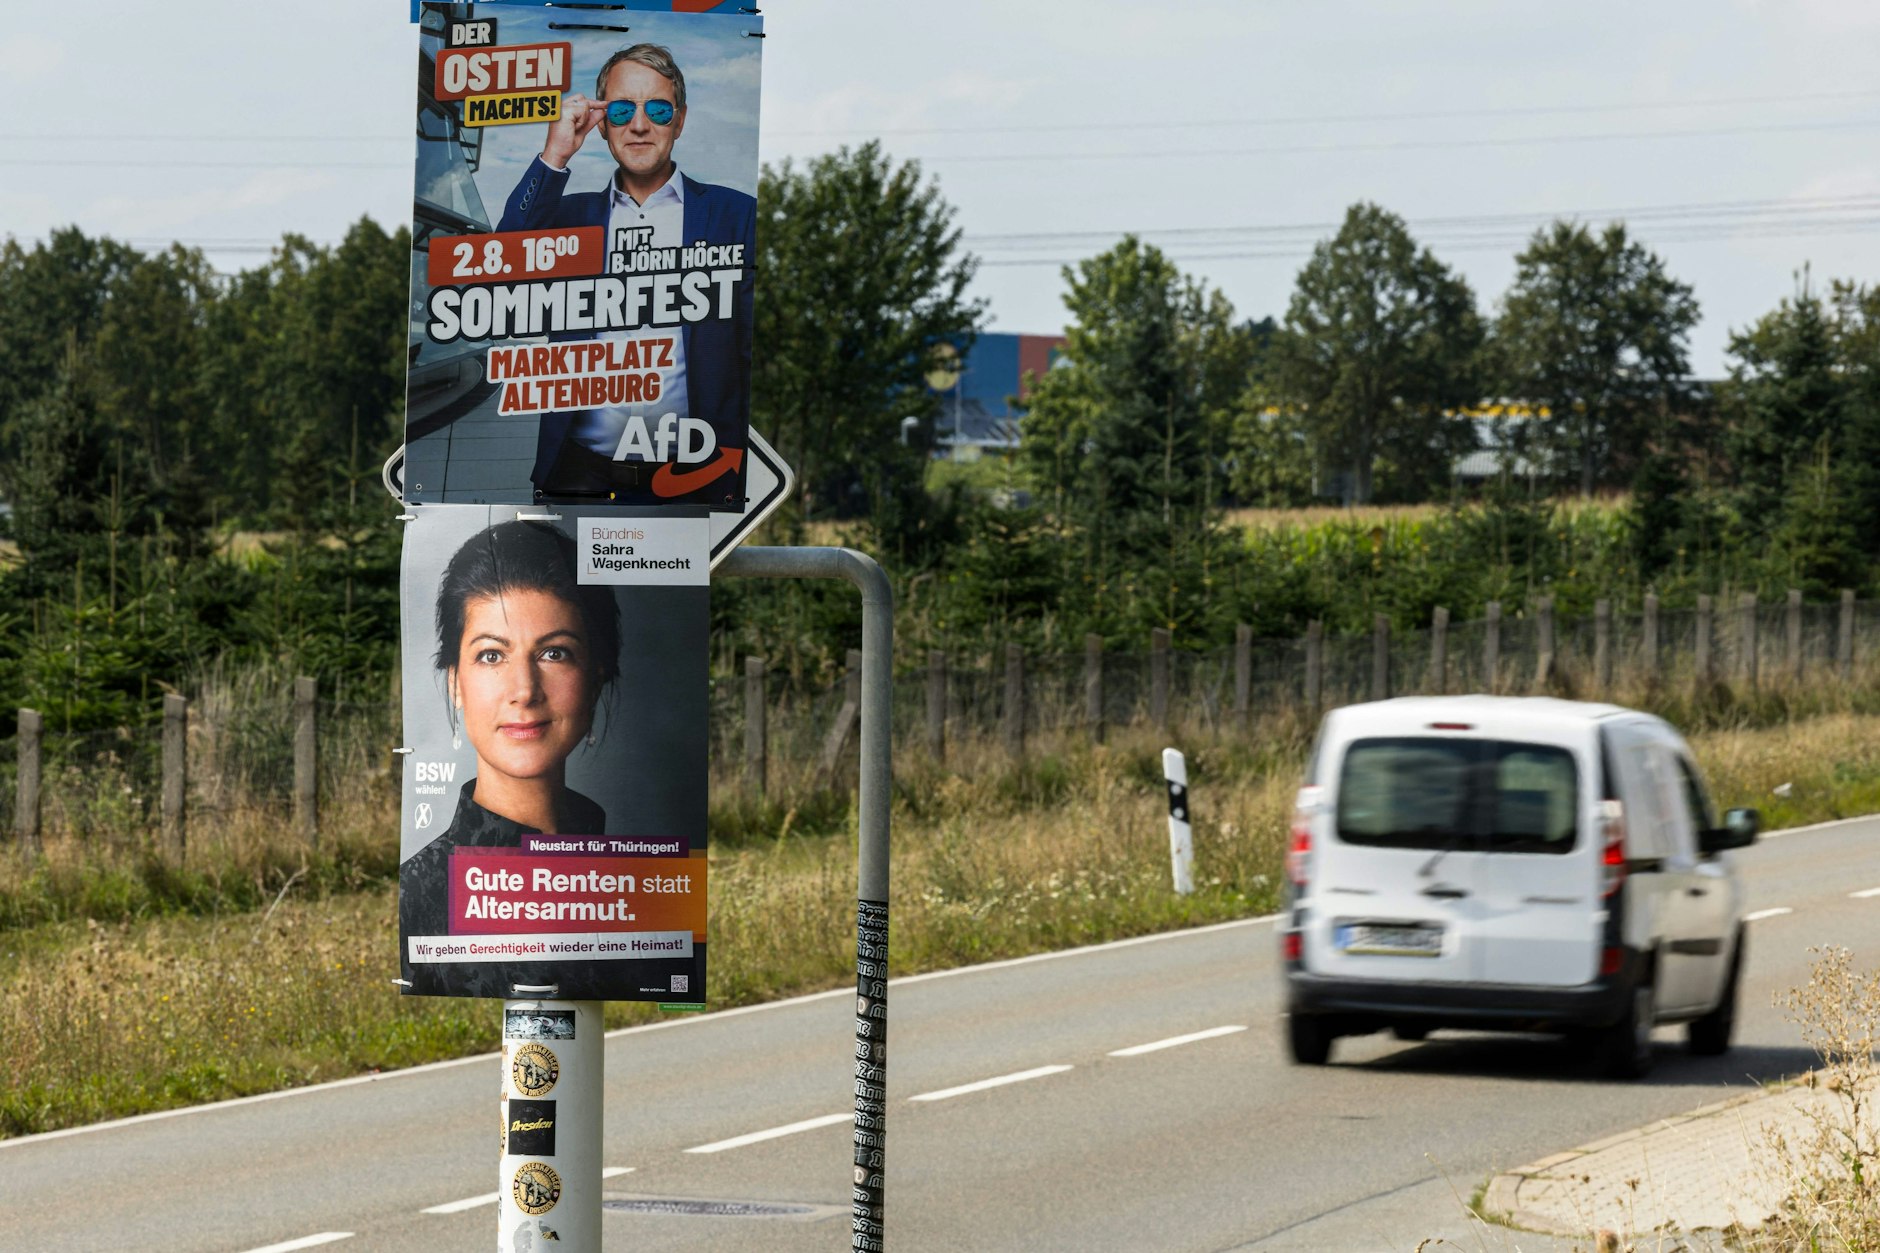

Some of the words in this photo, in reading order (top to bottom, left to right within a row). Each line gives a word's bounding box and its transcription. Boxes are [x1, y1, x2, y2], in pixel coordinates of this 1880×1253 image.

[451, 21, 490, 46] DER
[443, 47, 564, 94] OSTEN
[469, 95, 557, 122] MACHTS!
[617, 228, 653, 251] MIT
[452, 241, 512, 277] 2.8.
[611, 244, 676, 274] BJÖRN
[681, 241, 744, 268] HÖCKE
[431, 269, 743, 341] SOMMERFEST
[490, 338, 673, 380] MARKTPLATZ
[501, 372, 660, 412] ALTENBURG
[612, 412, 717, 464] AfD
[592, 527, 644, 540] Bündnis
[592, 543, 634, 555] Sahra
[592, 557, 691, 571] Wagenknecht
[415, 762, 456, 782] BSW
[415, 784, 446, 795] wählen!
[529, 840, 584, 852] Neustart
[587, 840, 606, 852] für
[609, 840, 679, 855] Thüringen!
[465, 867, 524, 892] Gute
[532, 868, 636, 893] Renten
[642, 875, 691, 894] statt
[465, 895, 636, 921] Altersarmut.
[416, 944, 433, 955] Wir
[435, 944, 467, 957] geben
[469, 942, 546, 957] Gerechtigkeit
[550, 940, 594, 953] wieder
[598, 940, 627, 952] eine
[631, 938, 683, 951] Heimat!
[510, 1117, 553, 1133] Dresden
